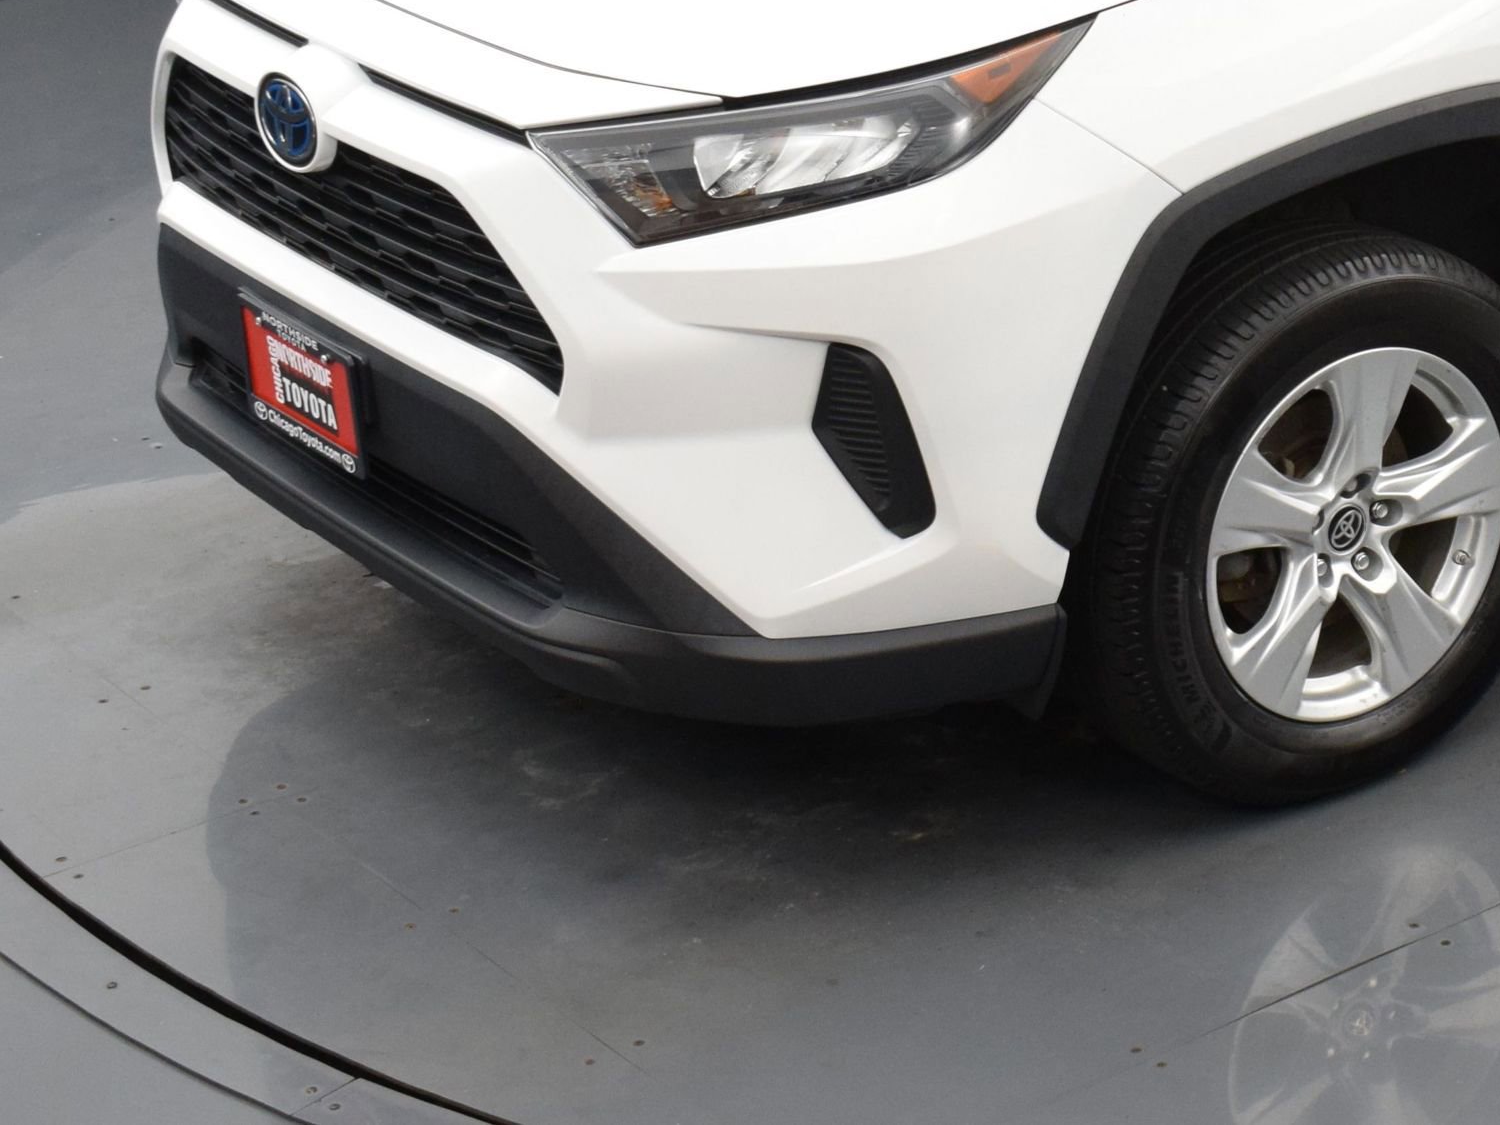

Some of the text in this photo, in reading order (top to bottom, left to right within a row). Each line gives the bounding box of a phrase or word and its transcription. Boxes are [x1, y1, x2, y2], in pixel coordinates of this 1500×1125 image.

[262, 311, 319, 351] NORTHSIDE
[276, 329, 306, 352] TOYOTA
[266, 335, 285, 404] CHICAGO
[281, 376, 338, 430] TOYOTA
[268, 409, 342, 464] ChicagoToyota.com
